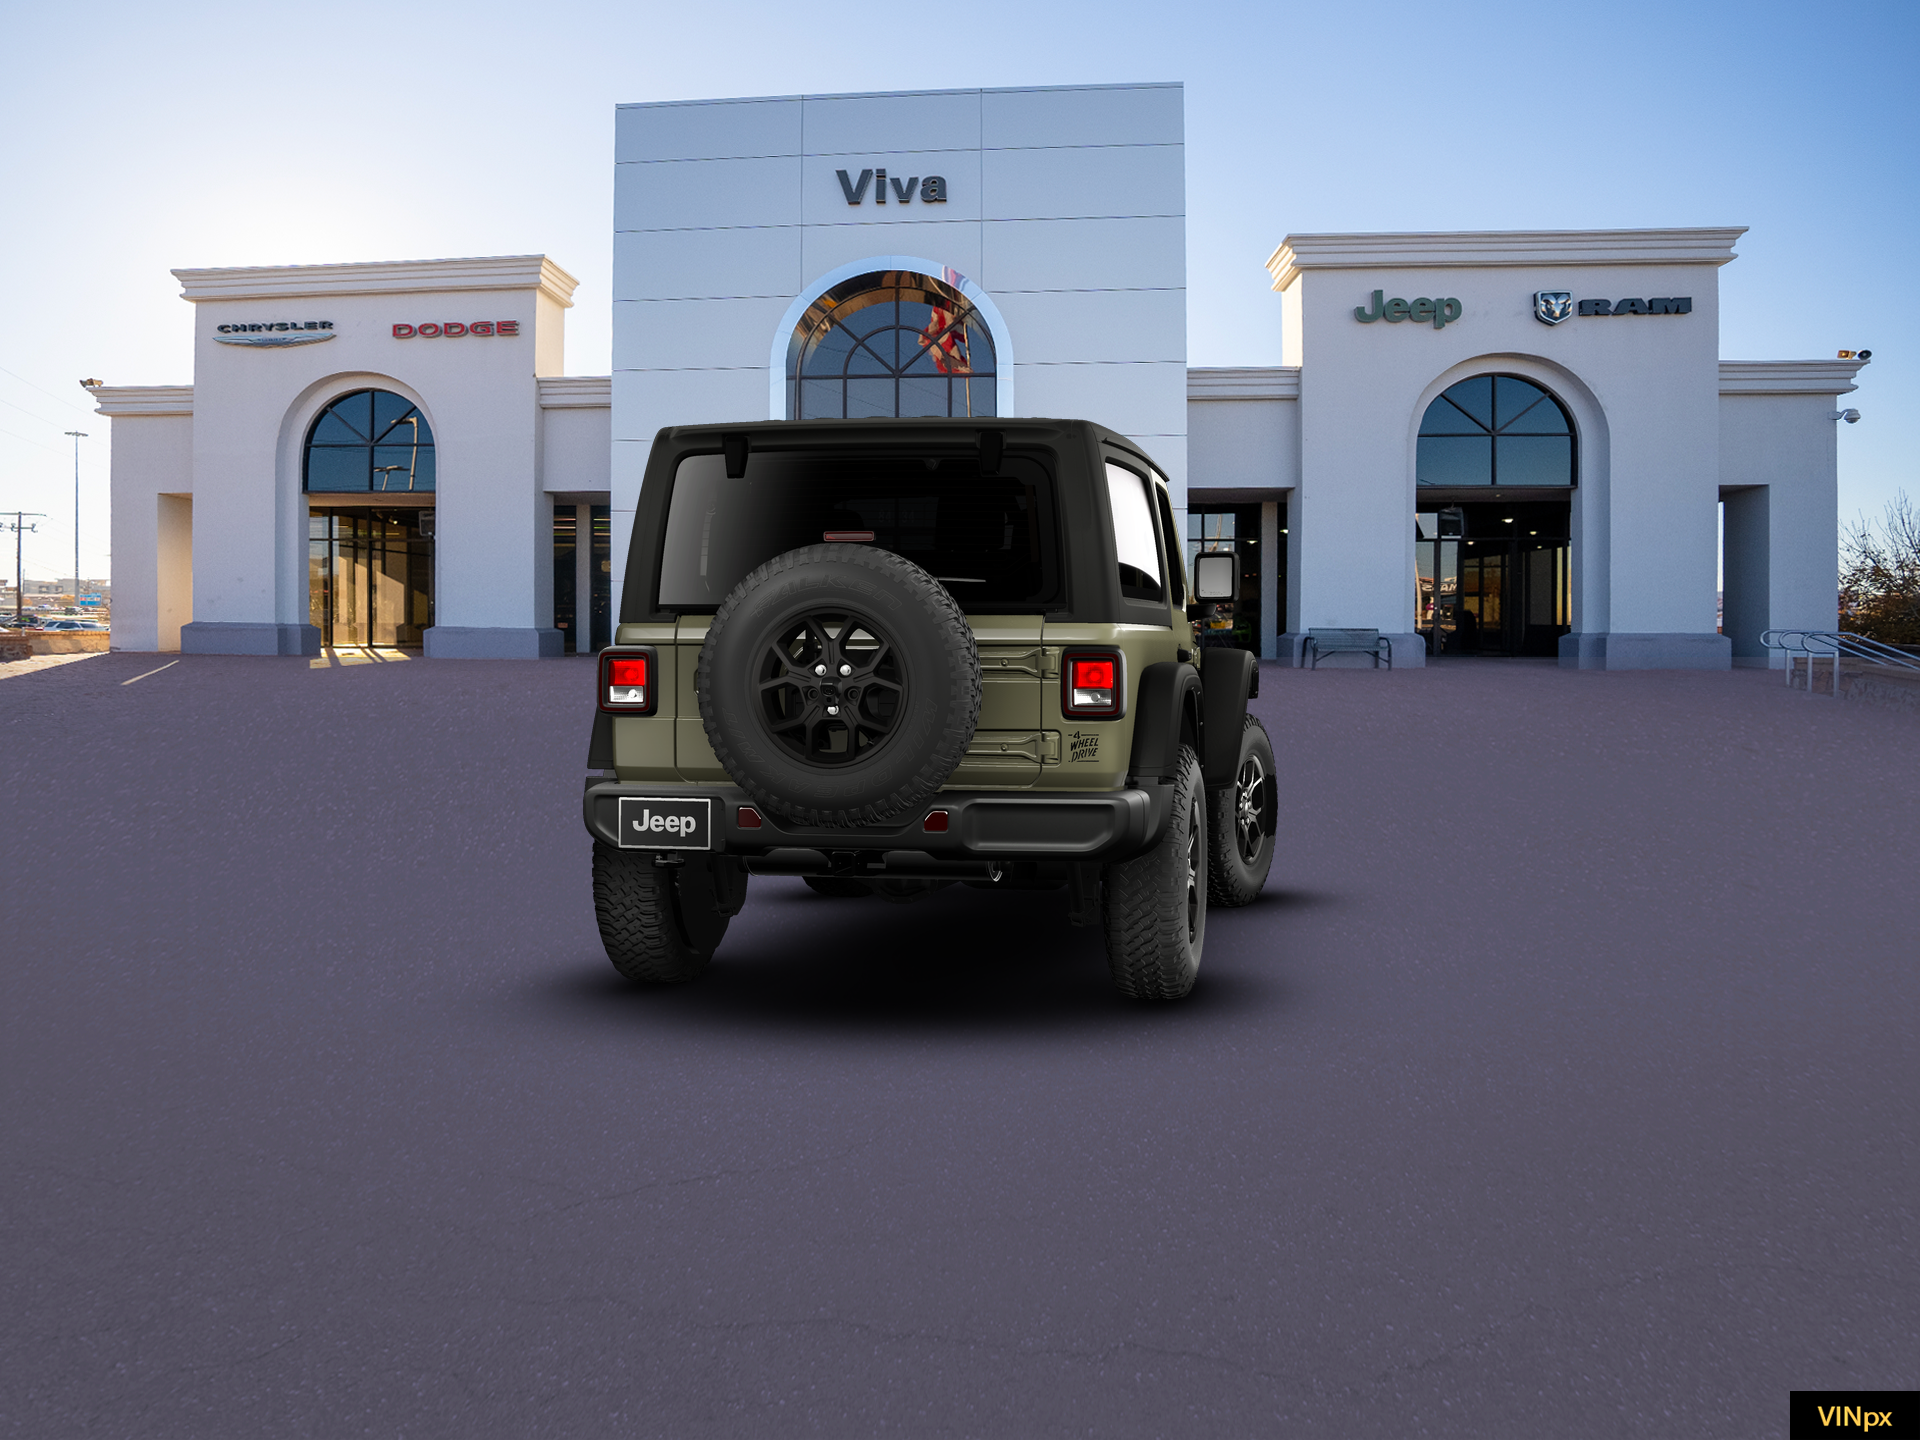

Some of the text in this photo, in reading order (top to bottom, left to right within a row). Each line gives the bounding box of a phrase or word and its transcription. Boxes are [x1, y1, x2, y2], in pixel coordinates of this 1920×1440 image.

[835, 168, 947, 205] Viva
[1354, 289, 1462, 329] Jeep
[1578, 297, 1692, 316] RAM
[217, 321, 333, 333] CHRYSLER
[392, 320, 519, 339] DODGE
[1070, 738, 1099, 751] WHEEL
[1073, 731, 1080, 739] 4
[1071, 748, 1098, 763] DRIVE
[632, 809, 696, 837] Jeep
